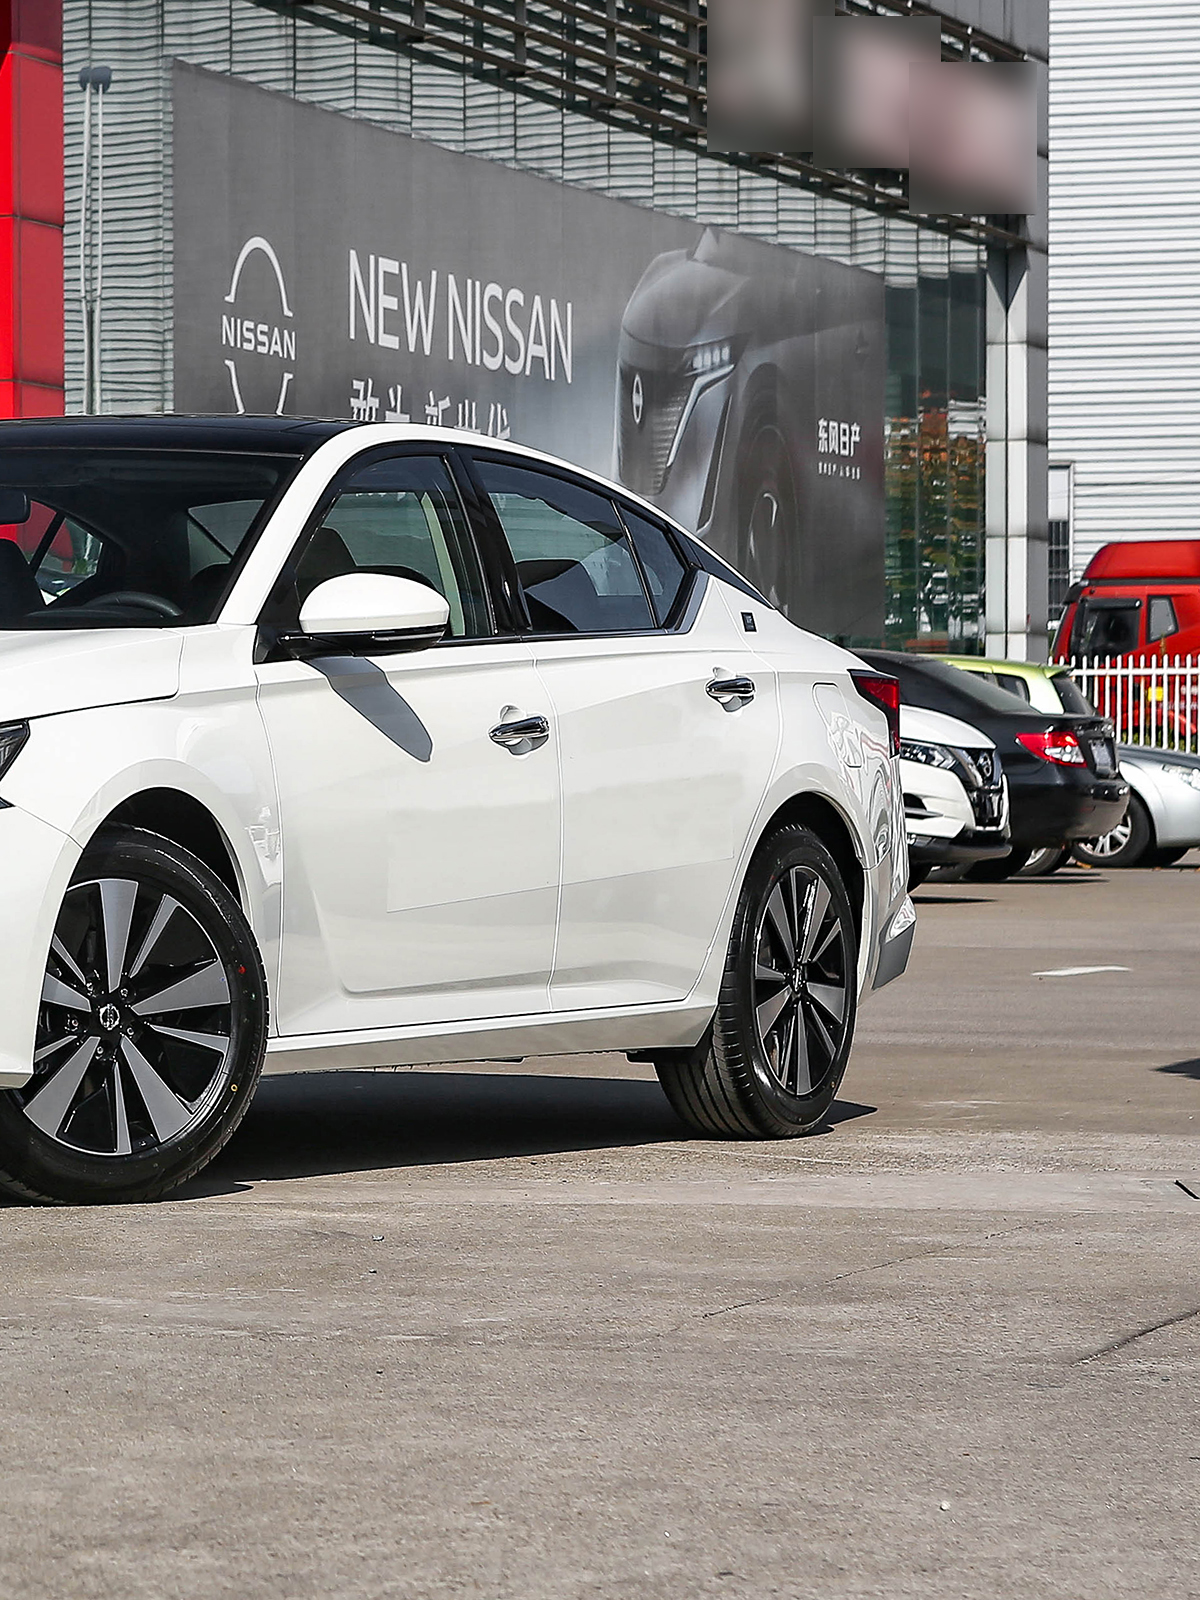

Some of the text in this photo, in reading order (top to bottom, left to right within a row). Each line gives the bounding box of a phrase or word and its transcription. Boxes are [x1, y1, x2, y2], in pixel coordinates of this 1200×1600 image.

[222, 315, 296, 361] NISSAN
[349, 249, 572, 384] NEW NISSAN
[818, 418, 861, 457] 东风日产
